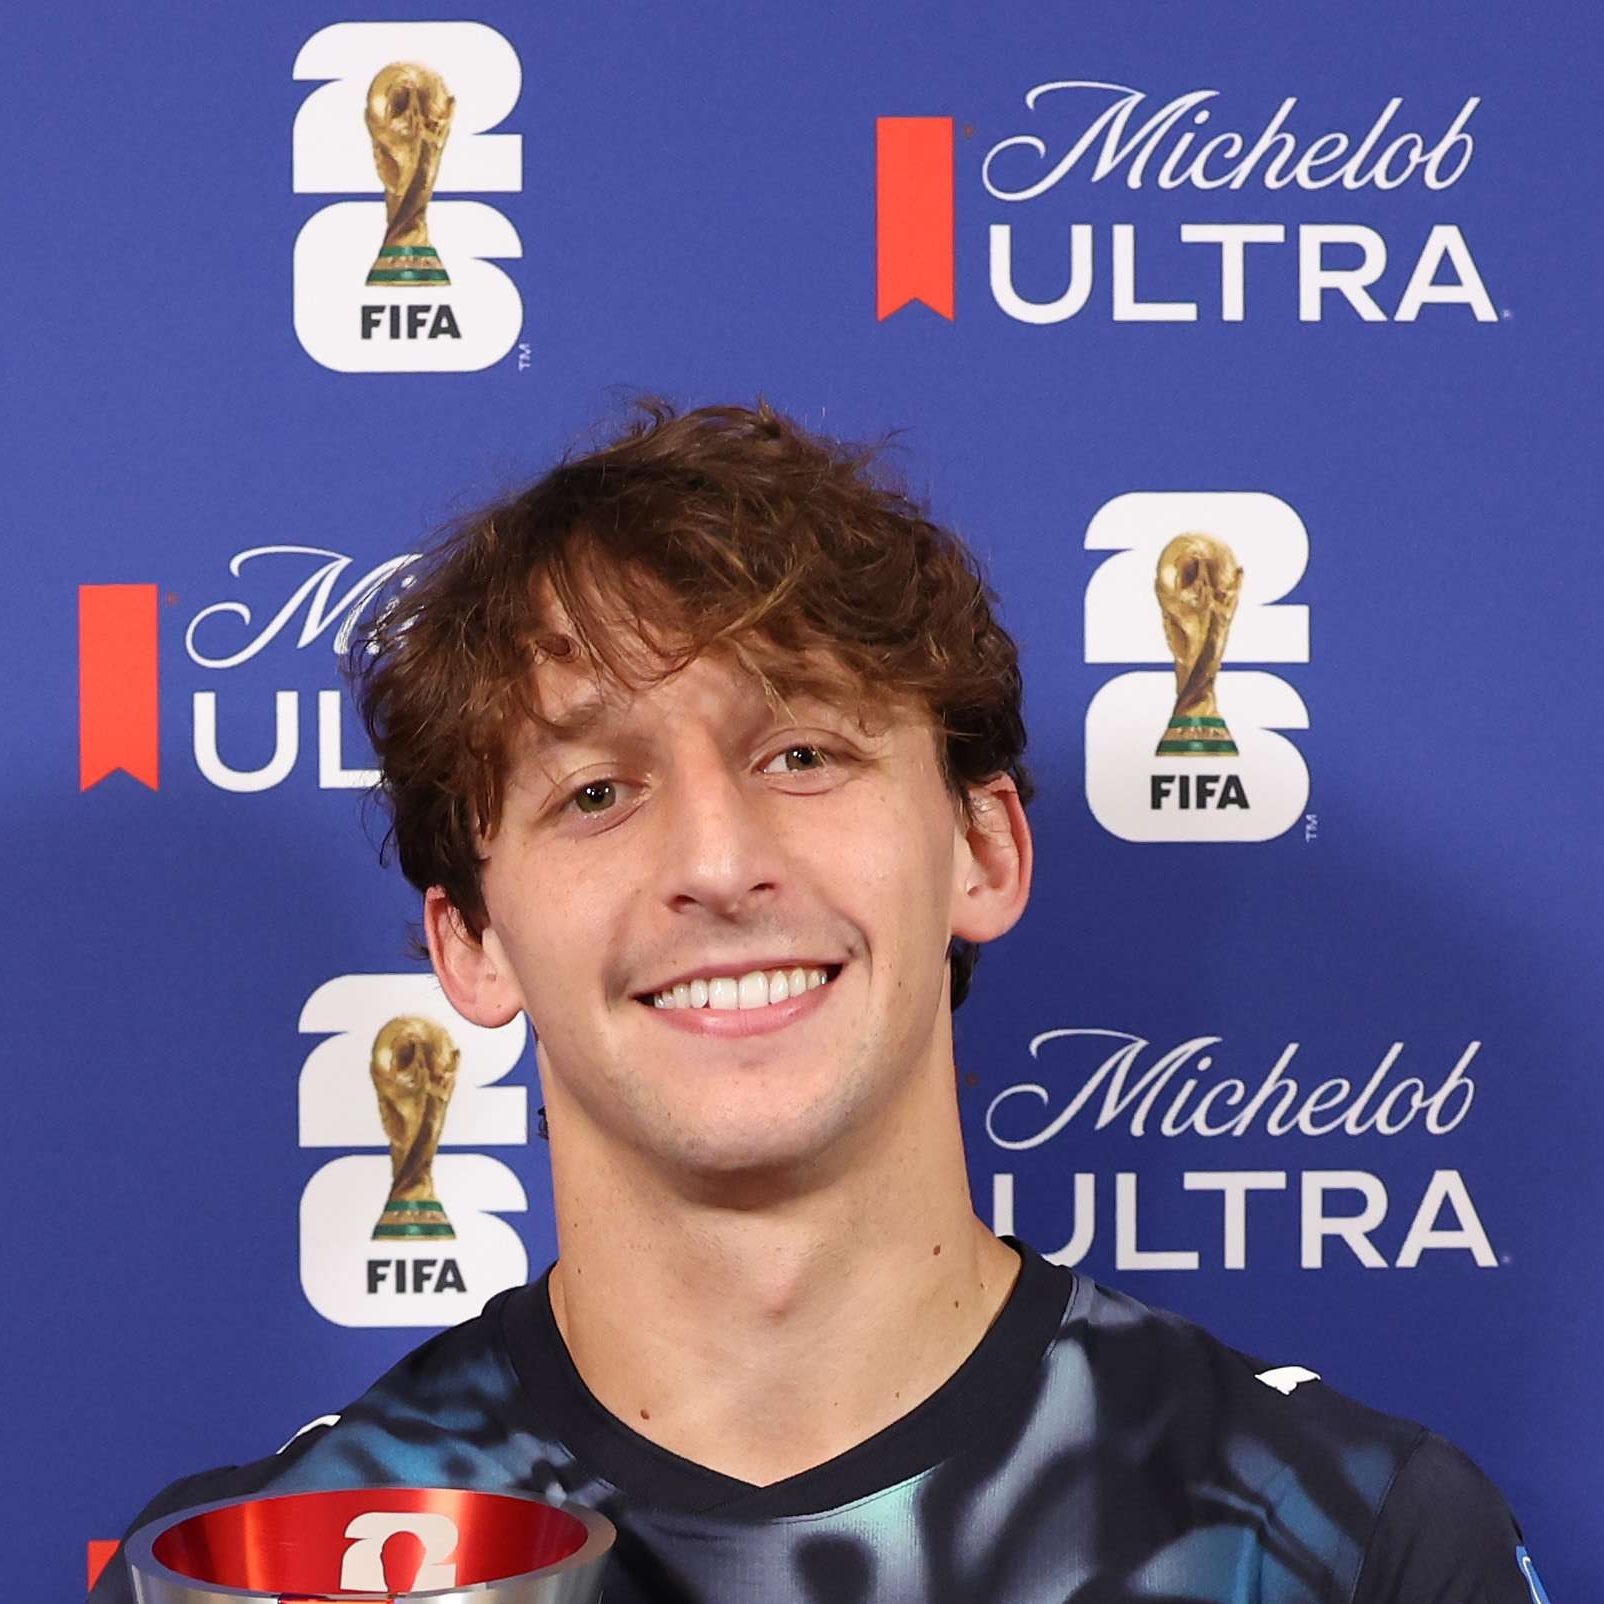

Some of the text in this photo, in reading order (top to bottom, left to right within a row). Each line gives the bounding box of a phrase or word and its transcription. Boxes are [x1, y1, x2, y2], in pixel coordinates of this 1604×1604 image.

[983, 81, 1480, 200] Michelob
[361, 305, 461, 339] FIFA
[990, 224, 1498, 324] ULTRA
[1151, 775, 1249, 810] FIFA
[986, 1029, 1481, 1149] Michelob
[992, 1170, 1498, 1270] ULTRA
[367, 1259, 467, 1294] FIFA
